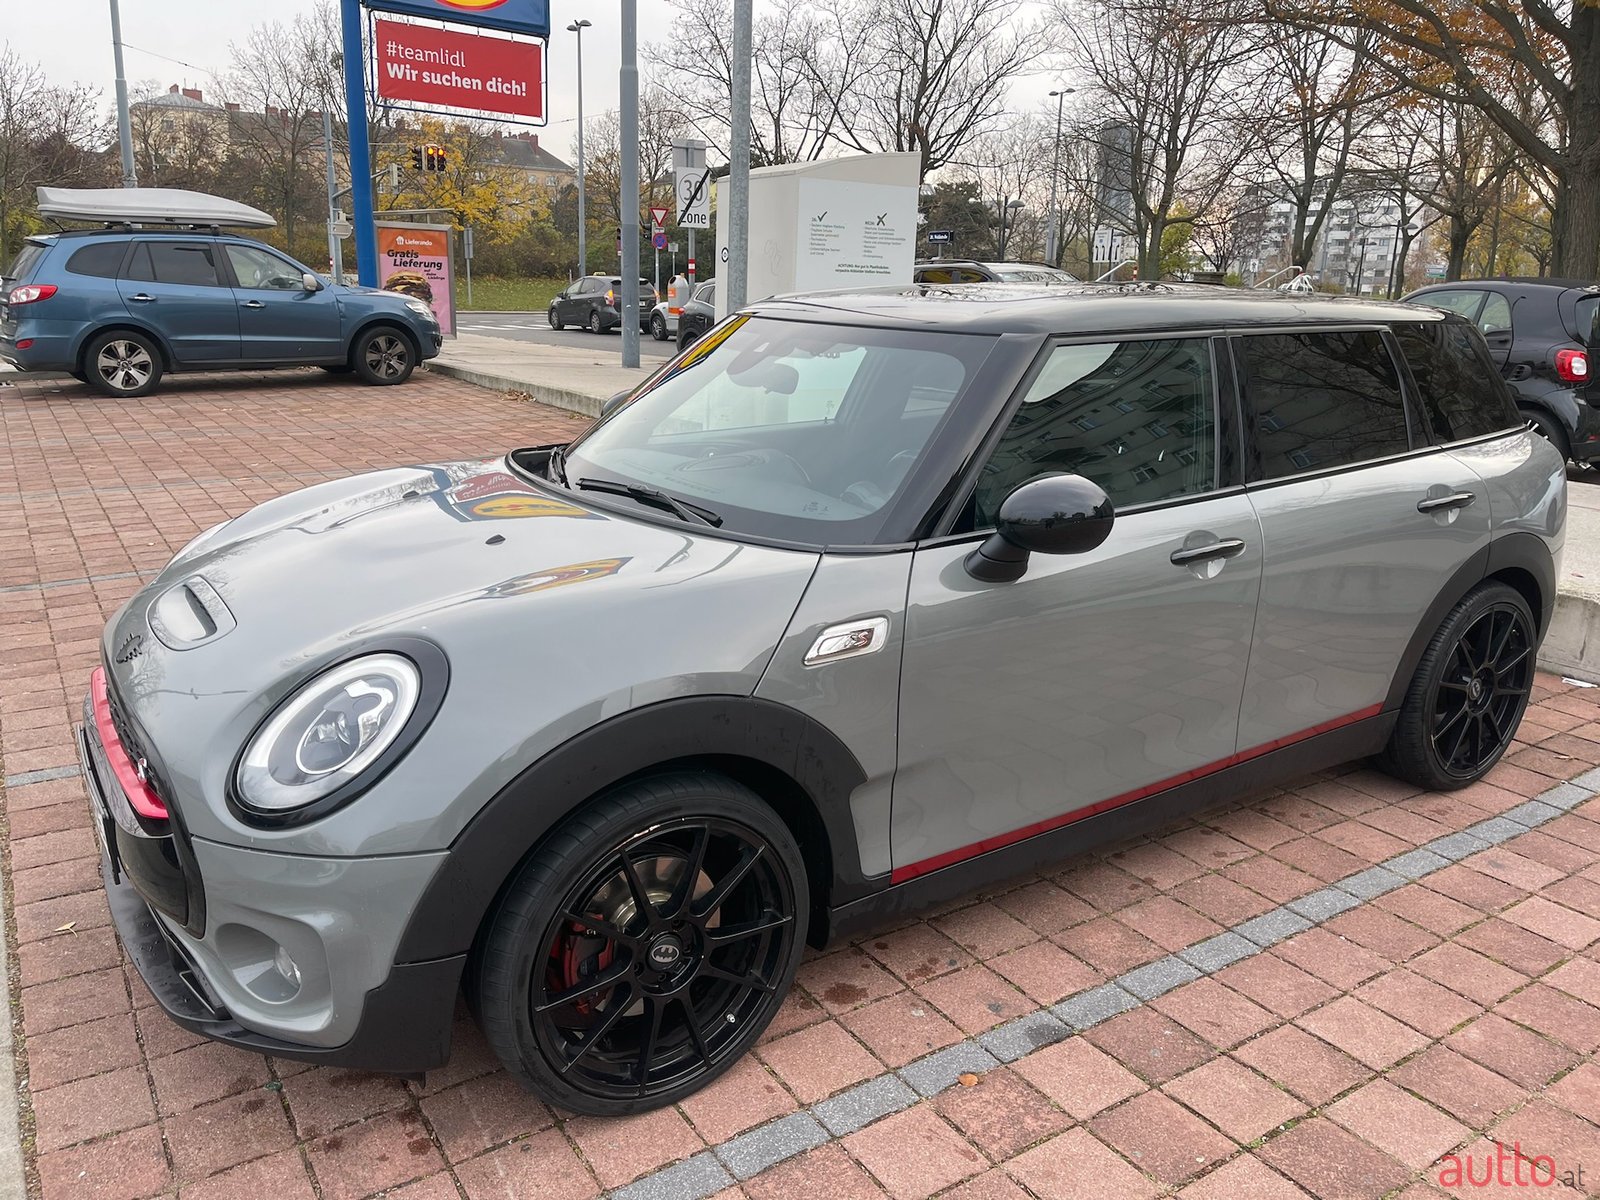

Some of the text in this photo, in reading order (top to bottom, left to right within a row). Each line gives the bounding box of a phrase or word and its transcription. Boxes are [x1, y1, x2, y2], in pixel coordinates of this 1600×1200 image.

[386, 40, 466, 68] #teamlidl
[386, 62, 527, 97] Wir suchen dich!
[683, 179, 703, 202] 30
[387, 249, 419, 259] Gratis
[393, 258, 443, 270] Lieferung
